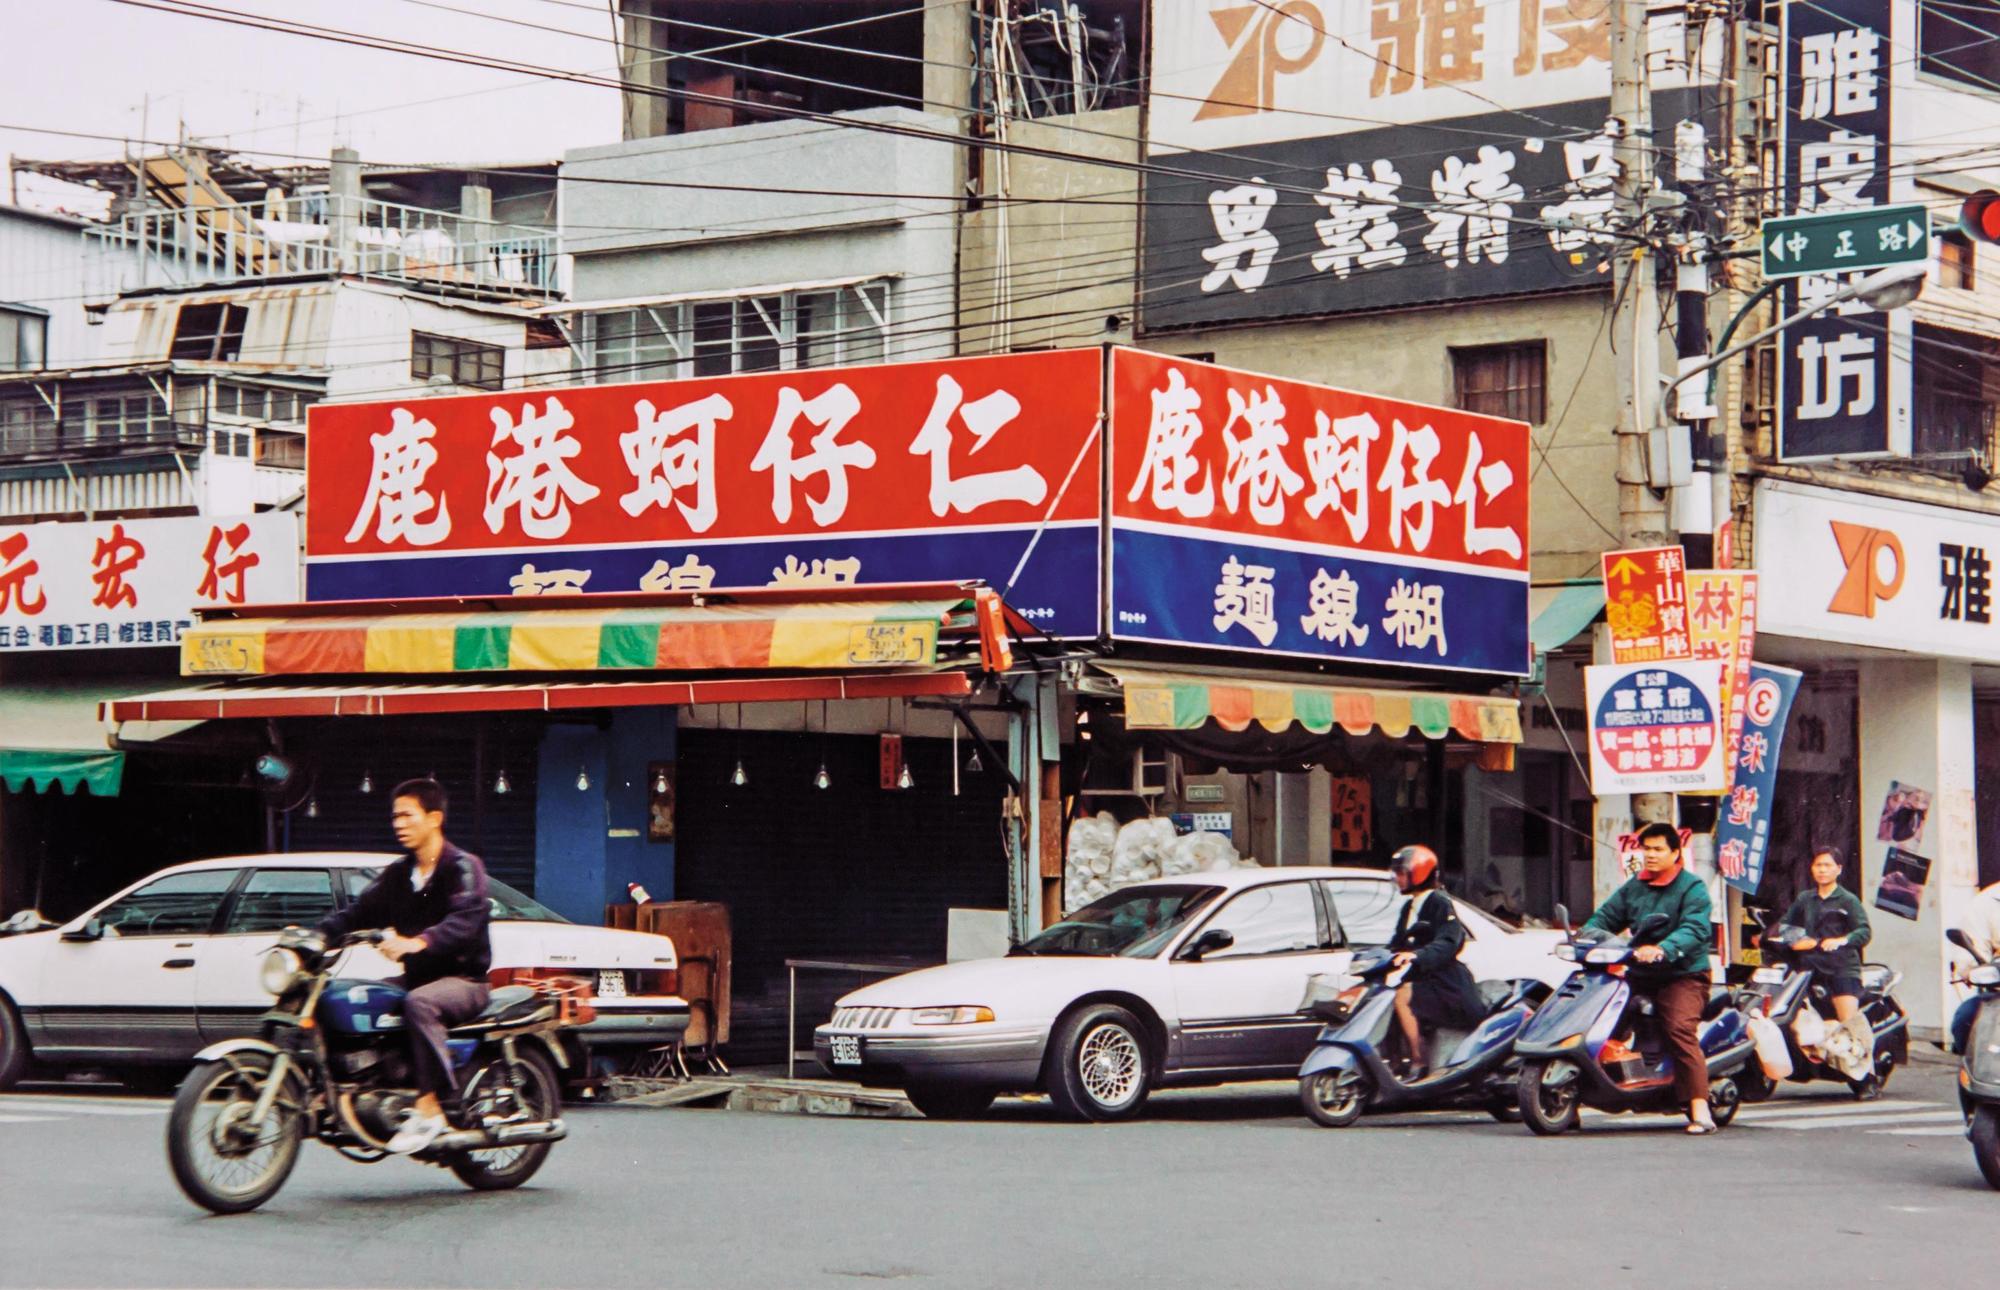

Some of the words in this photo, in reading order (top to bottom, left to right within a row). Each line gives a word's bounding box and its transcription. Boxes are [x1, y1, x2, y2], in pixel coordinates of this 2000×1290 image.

[1786, 223, 1907, 262] 中正路
[344, 373, 1049, 546] 鹿港蚵仔仁
[1127, 367, 1523, 560] 鹿港蚵仔仁
[0, 523, 260, 616] 元宏行
[1212, 554, 1447, 657] 麵線糊
[1939, 542, 1992, 625] 雅
